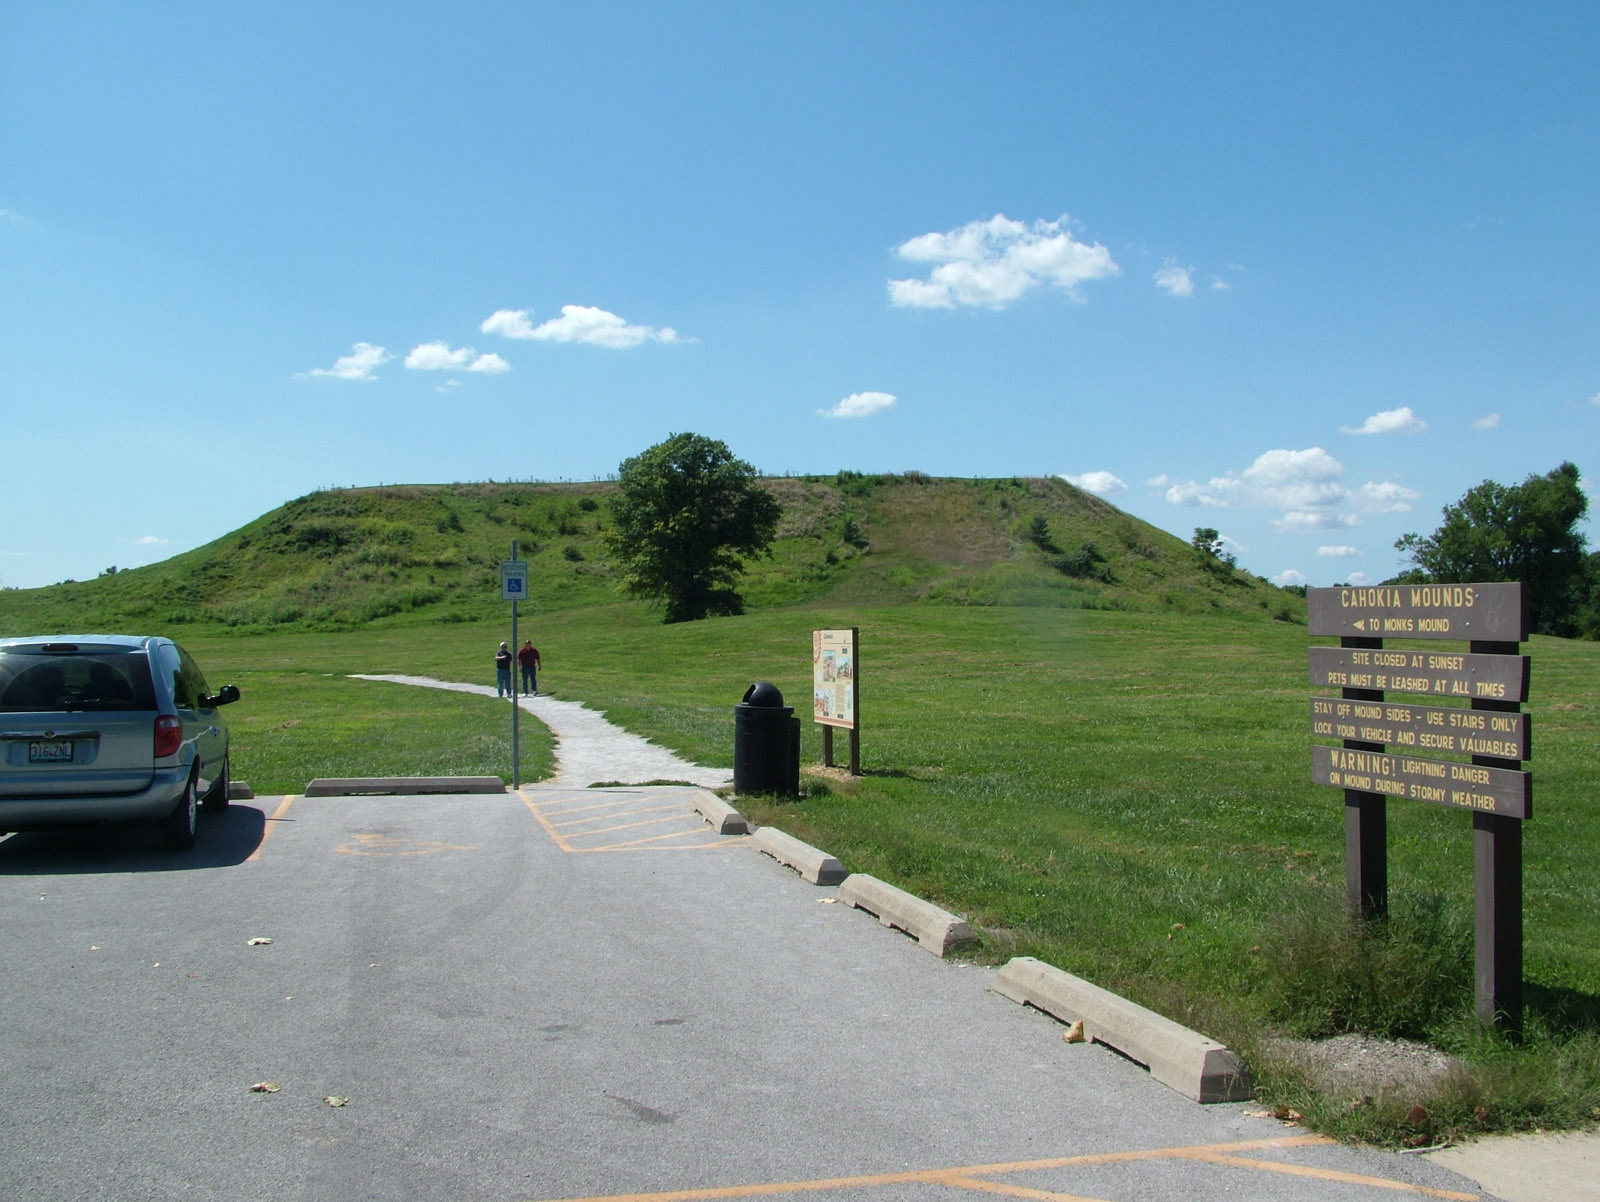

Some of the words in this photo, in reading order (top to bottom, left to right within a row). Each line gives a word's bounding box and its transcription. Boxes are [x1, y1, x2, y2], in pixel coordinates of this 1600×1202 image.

[1342, 589, 1400, 607] CAHOKIA
[1412, 587, 1474, 607] MOUNDS
[1370, 619, 1379, 630] TO
[1384, 619, 1413, 631] MONKS
[1419, 619, 1449, 631] MOUND
[1353, 653, 1369, 665] SITE
[1374, 654, 1406, 666] CLOSED
[1412, 656, 1423, 668] AT
[1429, 656, 1463, 670] SUNSET
[1328, 672, 1346, 684] PETS
[1351, 674, 1372, 686] MUST
[1377, 676, 1386, 688] BE
[1392, 677, 1428, 691] LEASHED
[1435, 680, 1446, 692] AT
[1452, 681, 1469, 694] ALL
[1477, 682, 1505, 697] TIMES
[1314, 702, 1333, 713] STAY
[1337, 704, 1350, 715] OFF
[1355, 706, 1381, 719] MOUND
[1387, 708, 1410, 722] SIDES
[1427, 712, 1444, 725] USE
[1450, 714, 1485, 729] STAIRS
[1491, 717, 1517, 732] ONLY
[31, 746, 49, 758] 316
[1314, 722, 1332, 734] LOCK
[1337, 725, 1355, 737] YOUR
[1361, 727, 1392, 742] VEHICLE
[1397, 732, 1415, 745] AND
[1420, 734, 1453, 749] SECURE
[1460, 738, 1517, 757] VALUABLES
[1331, 750, 1395, 776] WARNING!
[1402, 760, 1446, 778] LIGHTNING
[1452, 767, 1490, 784] DANGER
[1330, 773, 1340, 784] ON
[1344, 774, 1370, 789] MOUND
[1376, 779, 1405, 795] DURING
[1411, 785, 1445, 801] STORMY
[1452, 792, 1495, 810] WEATHER
